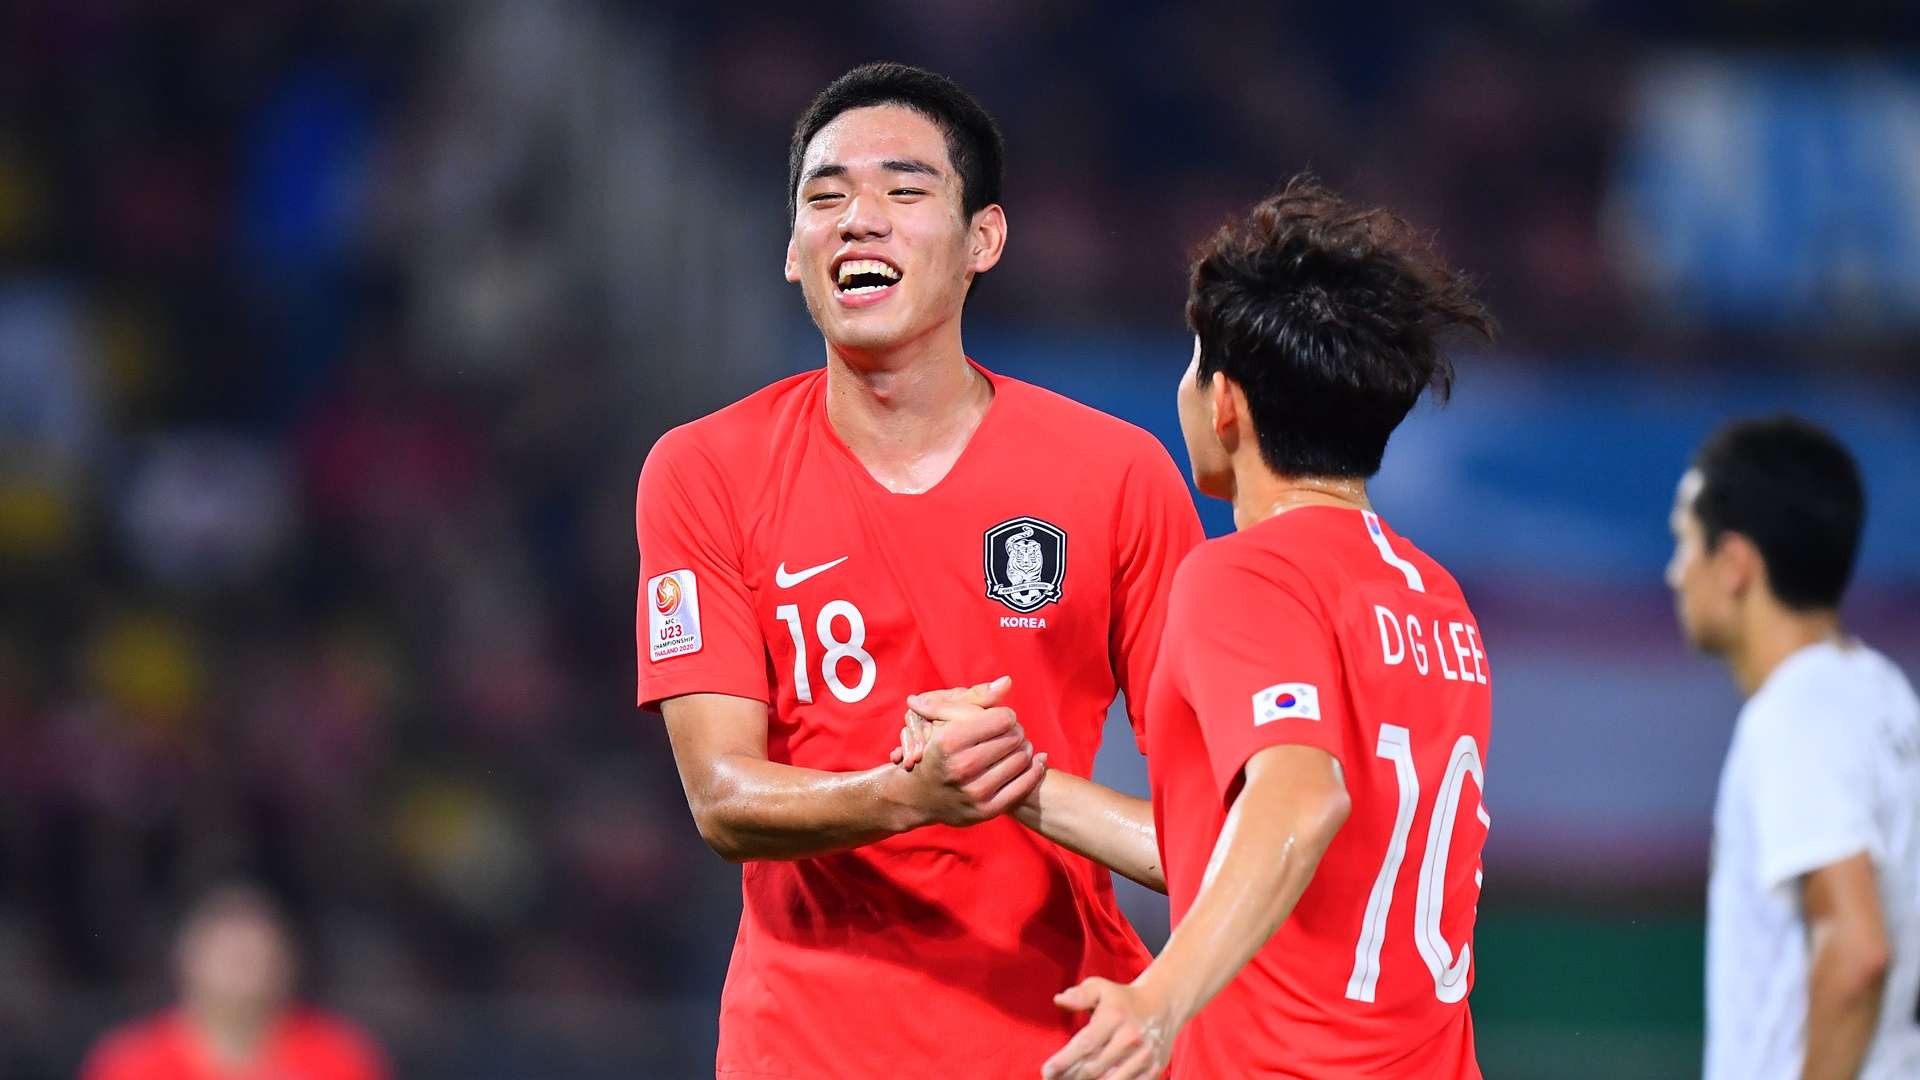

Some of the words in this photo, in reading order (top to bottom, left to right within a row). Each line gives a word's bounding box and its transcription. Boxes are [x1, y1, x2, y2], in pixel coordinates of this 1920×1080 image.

[1000, 616, 1047, 629] KOREA
[660, 624, 682, 641] U23
[653, 636, 695, 651] CHAMPIONSHIP
[654, 646, 679, 656] THAILAND
[679, 643, 694, 652] 2020
[776, 600, 877, 704] 18
[1433, 619, 1487, 685] LEE
[1344, 722, 1491, 1004] 10
